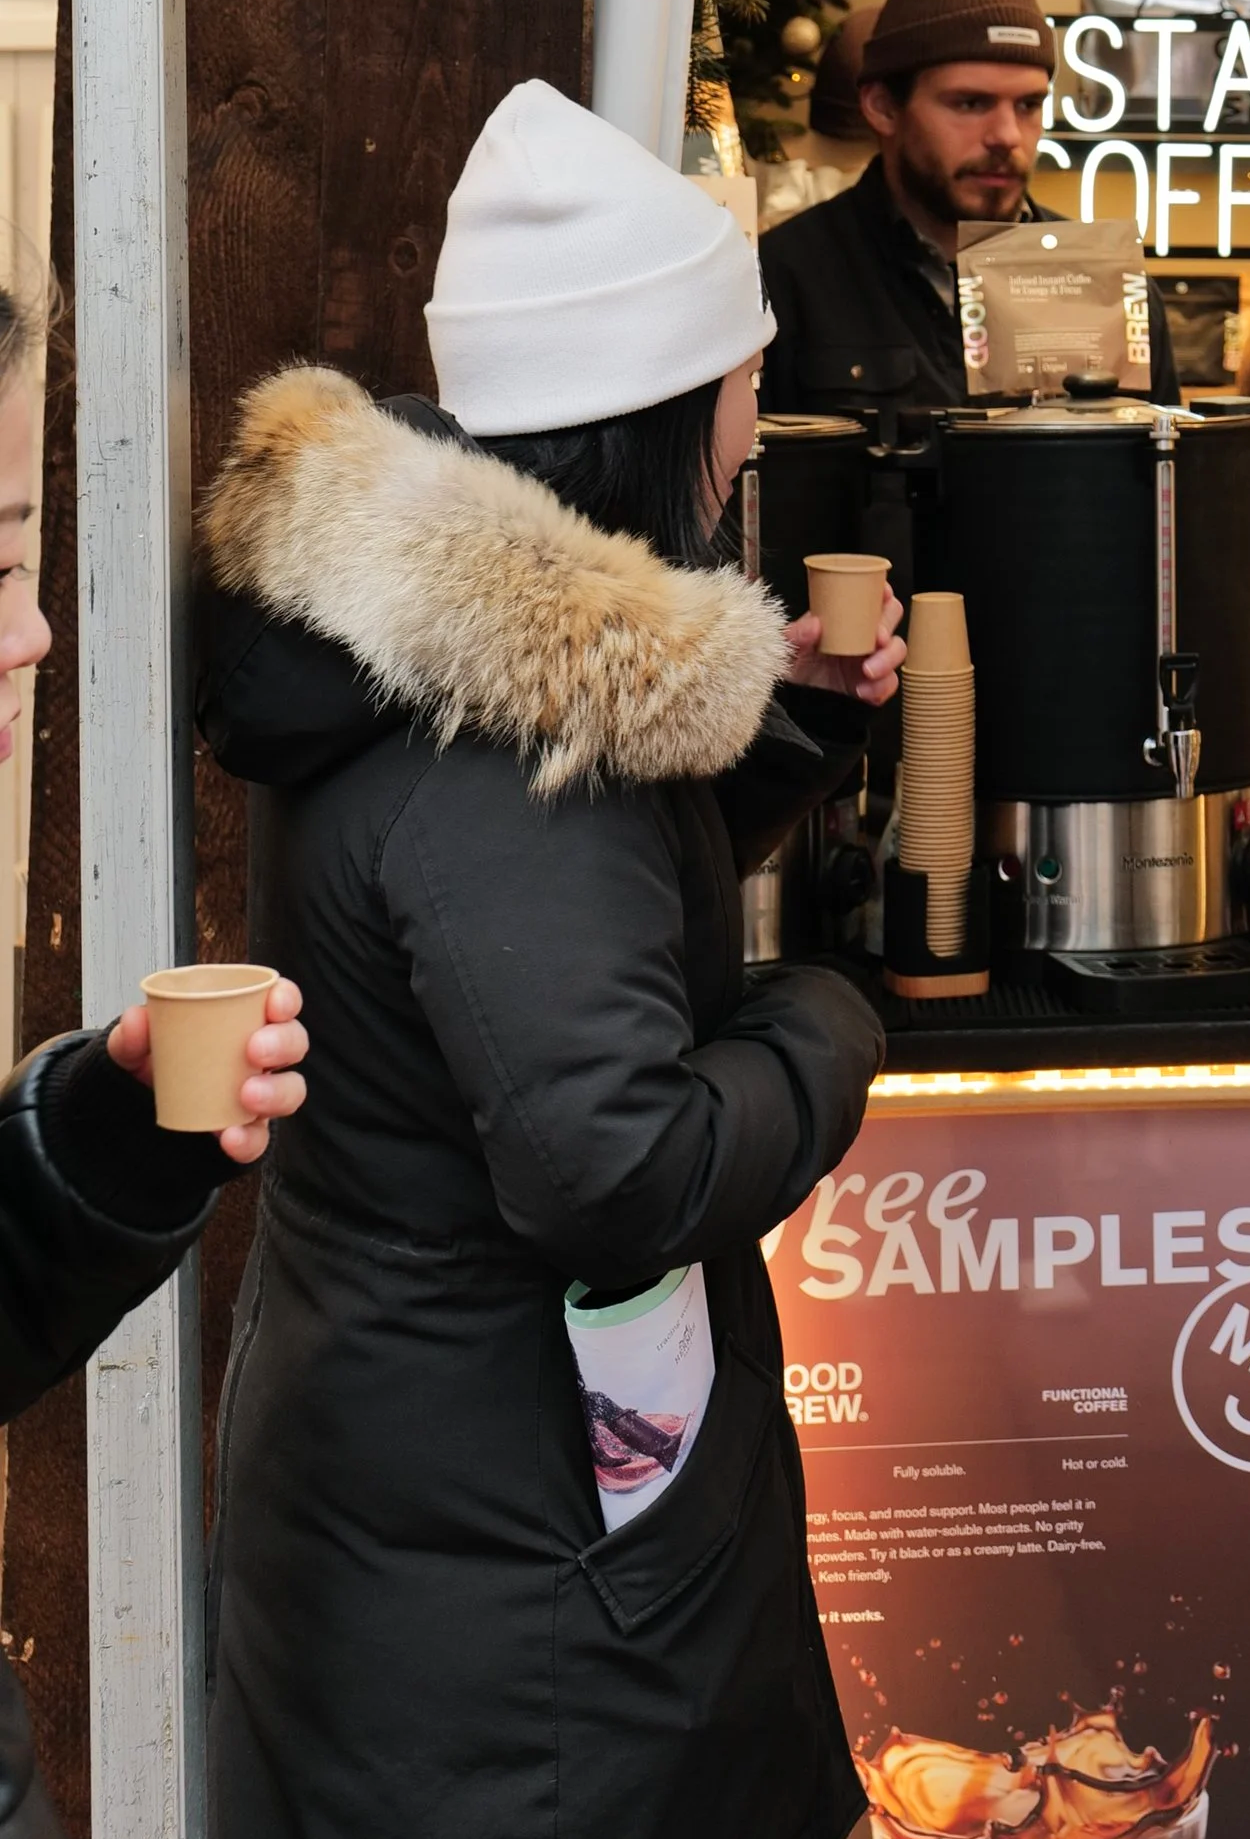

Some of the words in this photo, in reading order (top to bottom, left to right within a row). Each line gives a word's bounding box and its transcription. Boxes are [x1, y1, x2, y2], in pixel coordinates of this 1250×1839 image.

[958, 275, 990, 370] MOOD
[1122, 270, 1151, 364] BREW.
[784, 1362, 863, 1394] OOD
[1041, 1386, 1128, 1403] FUNCTIONAL
[1073, 1399, 1128, 1414] COFFEE
[893, 1465, 921, 1481] Fully
[921, 1463, 966, 1478] soluble.
[1062, 1458, 1084, 1471] Hot
[1085, 1460, 1099, 1470] or
[1100, 1456, 1128, 1469] cold.
[832, 1509, 868, 1523] focus,
[869, 1507, 892, 1521] and
[893, 1506, 927, 1519] mood
[928, 1504, 976, 1519] support.
[978, 1502, 1008, 1515] Most
[1009, 1500, 1050, 1516] people
[1051, 1498, 1073, 1512] feel
[1074, 1498, 1083, 1511] it
[1084, 1498, 1096, 1511] in
[844, 1528, 878, 1542] Made
[879, 1526, 904, 1540] with
[906, 1523, 983, 1539] water-soluble
[984, 1521, 1033, 1535] extracts.
[1034, 1520, 1053, 1533] No
[1054, 1518, 1085, 1534] gritty
[814, 1549, 868, 1566] powders.
[869, 1547, 887, 1563] Try
[889, 1546, 898, 1560] it
[899, 1545, 930, 1560] black
[931, 1547, 946, 1558] or
[946, 1546, 962, 1558] as
[962, 1546, 972, 1557] a
[973, 1542, 1016, 1558] creamy
[1016, 1541, 1046, 1555] latte.
[1046, 1538, 1107, 1555] Dairy-free,
[818, 1570, 847, 1584] Keto
[847, 1568, 893, 1584] friendly.
[828, 1611, 840, 1624] it
[841, 1609, 885, 1623] works.
